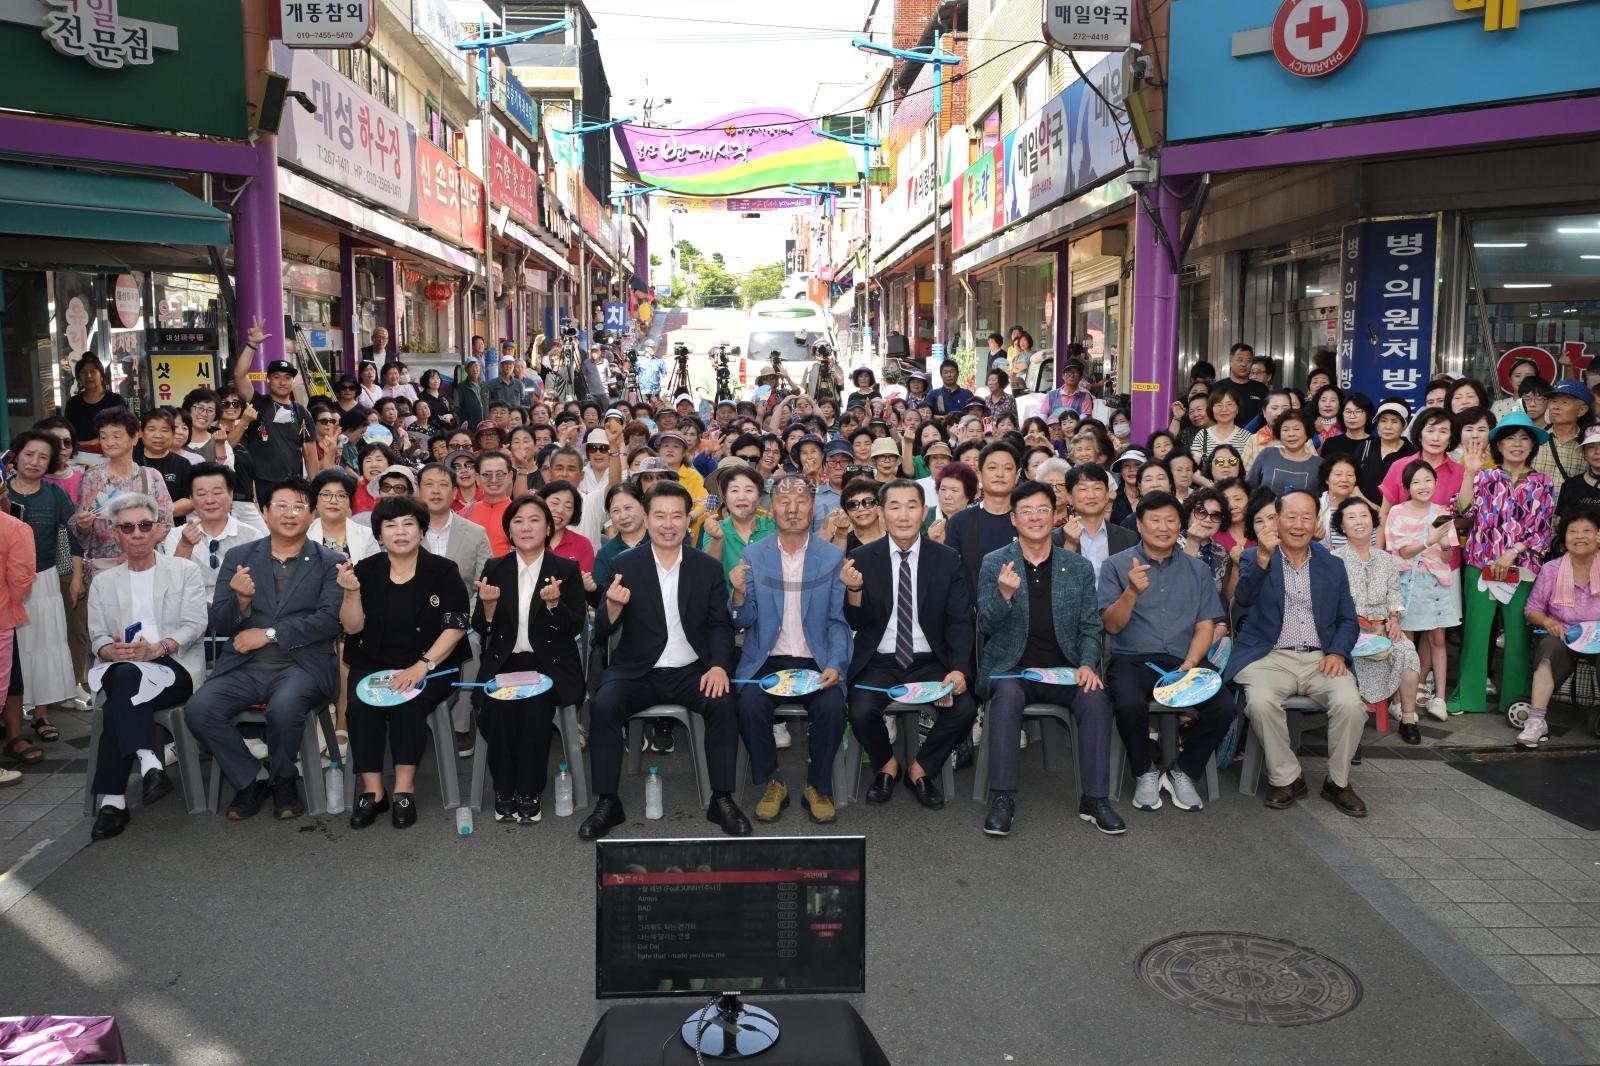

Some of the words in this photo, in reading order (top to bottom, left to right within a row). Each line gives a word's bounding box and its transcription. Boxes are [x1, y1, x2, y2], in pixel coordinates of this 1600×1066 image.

[286, 3, 363, 23] 개똥참외
[1055, 5, 1129, 25] 매일약국
[54, 15, 149, 63] 전문점
[1288, 51, 1344, 74] PHARMACY
[1018, 109, 1063, 178] 매일약국
[1379, 233, 1424, 410] 병·의원처방
